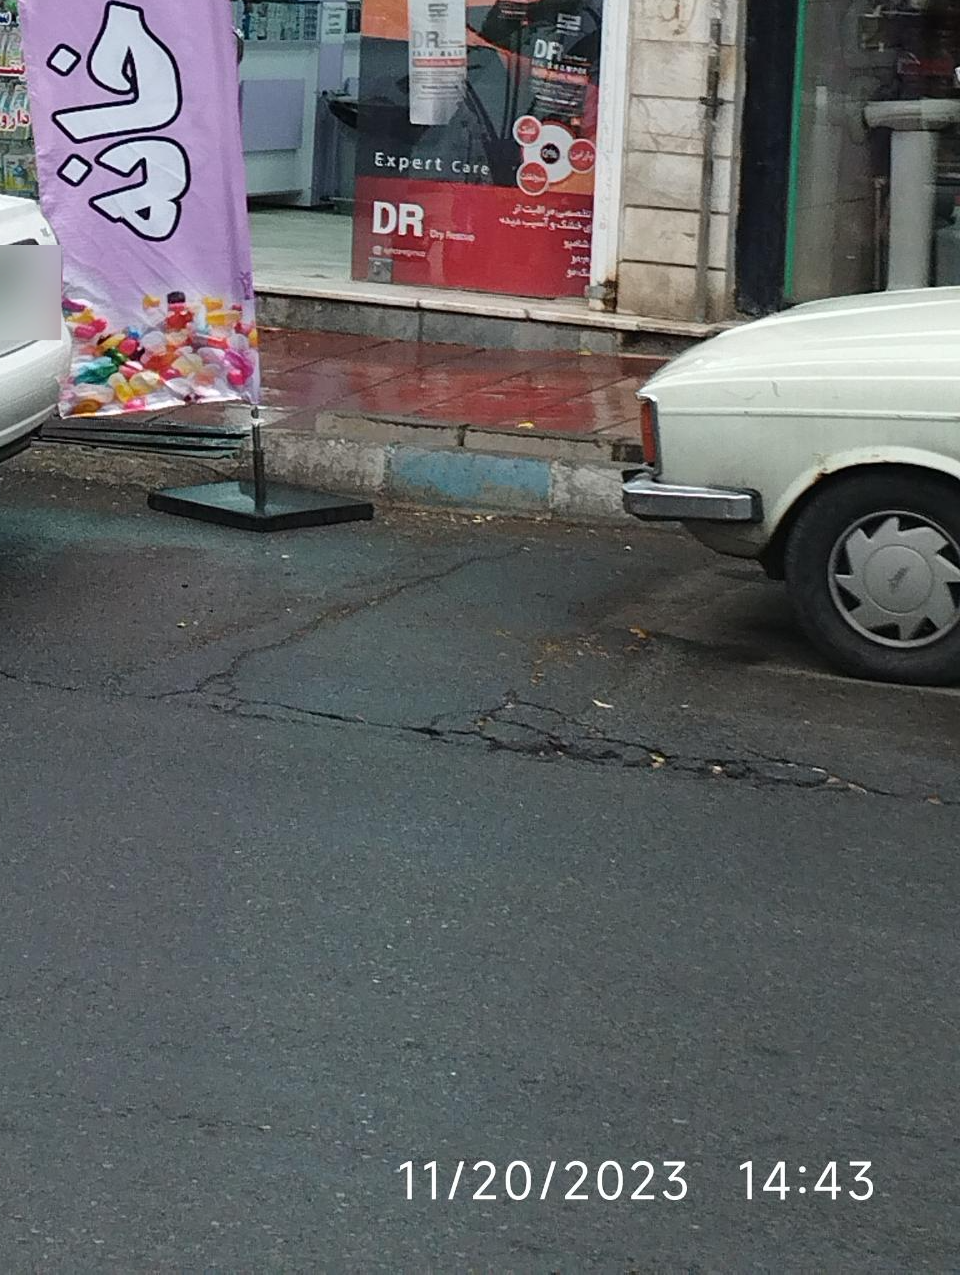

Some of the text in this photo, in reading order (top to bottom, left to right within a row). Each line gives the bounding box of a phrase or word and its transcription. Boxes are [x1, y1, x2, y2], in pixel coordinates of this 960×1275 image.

[374, 151, 490, 176] Expert Care
[371, 200, 425, 238] DR
